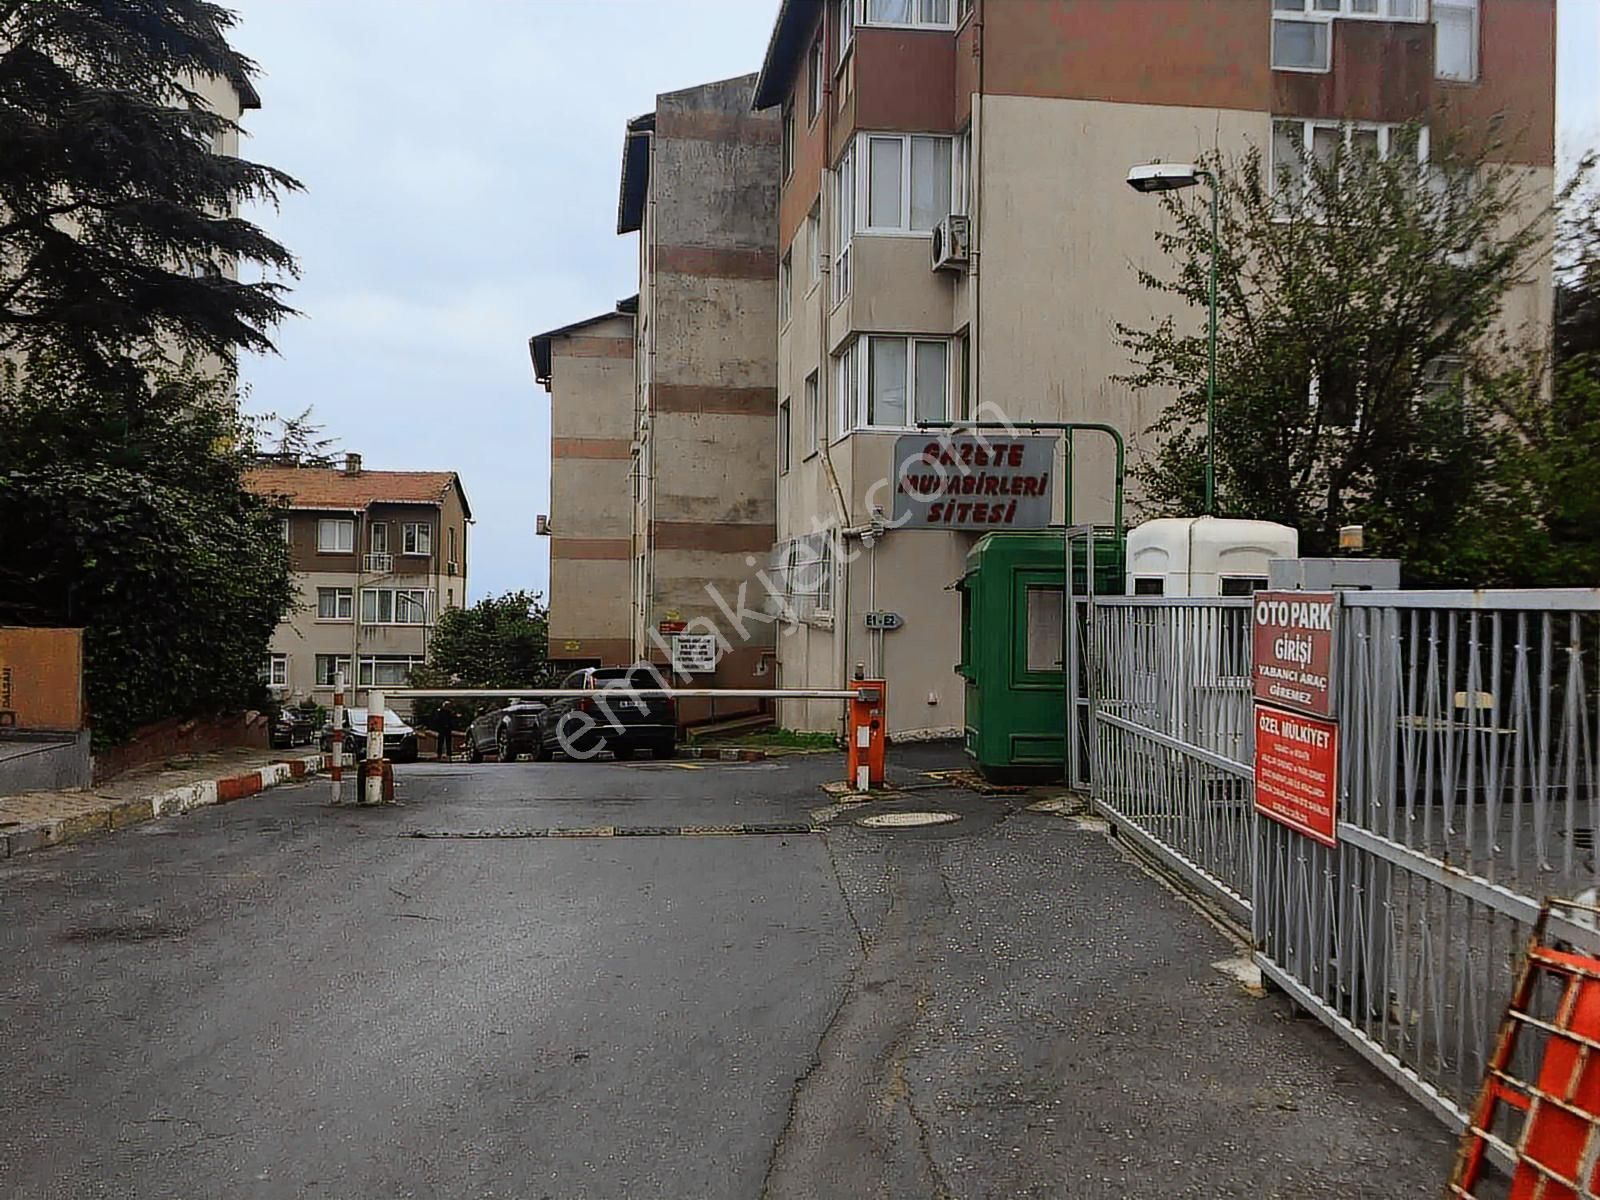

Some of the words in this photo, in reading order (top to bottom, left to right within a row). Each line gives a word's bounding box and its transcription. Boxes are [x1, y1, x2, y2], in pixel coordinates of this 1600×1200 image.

[922, 442, 1024, 467] GAZETE
[927, 499, 1017, 524] SİTESİ
[1275, 633, 1313, 670] GİRİŞİ
[1258, 665, 1298, 682] YABANCI
[1299, 672, 1327, 692] ARAÇ
[1269, 682, 1313, 705] GİREMEZ
[1259, 712, 1280, 736] ÖZEL
[1281, 719, 1330, 749] MÜLKİYET
